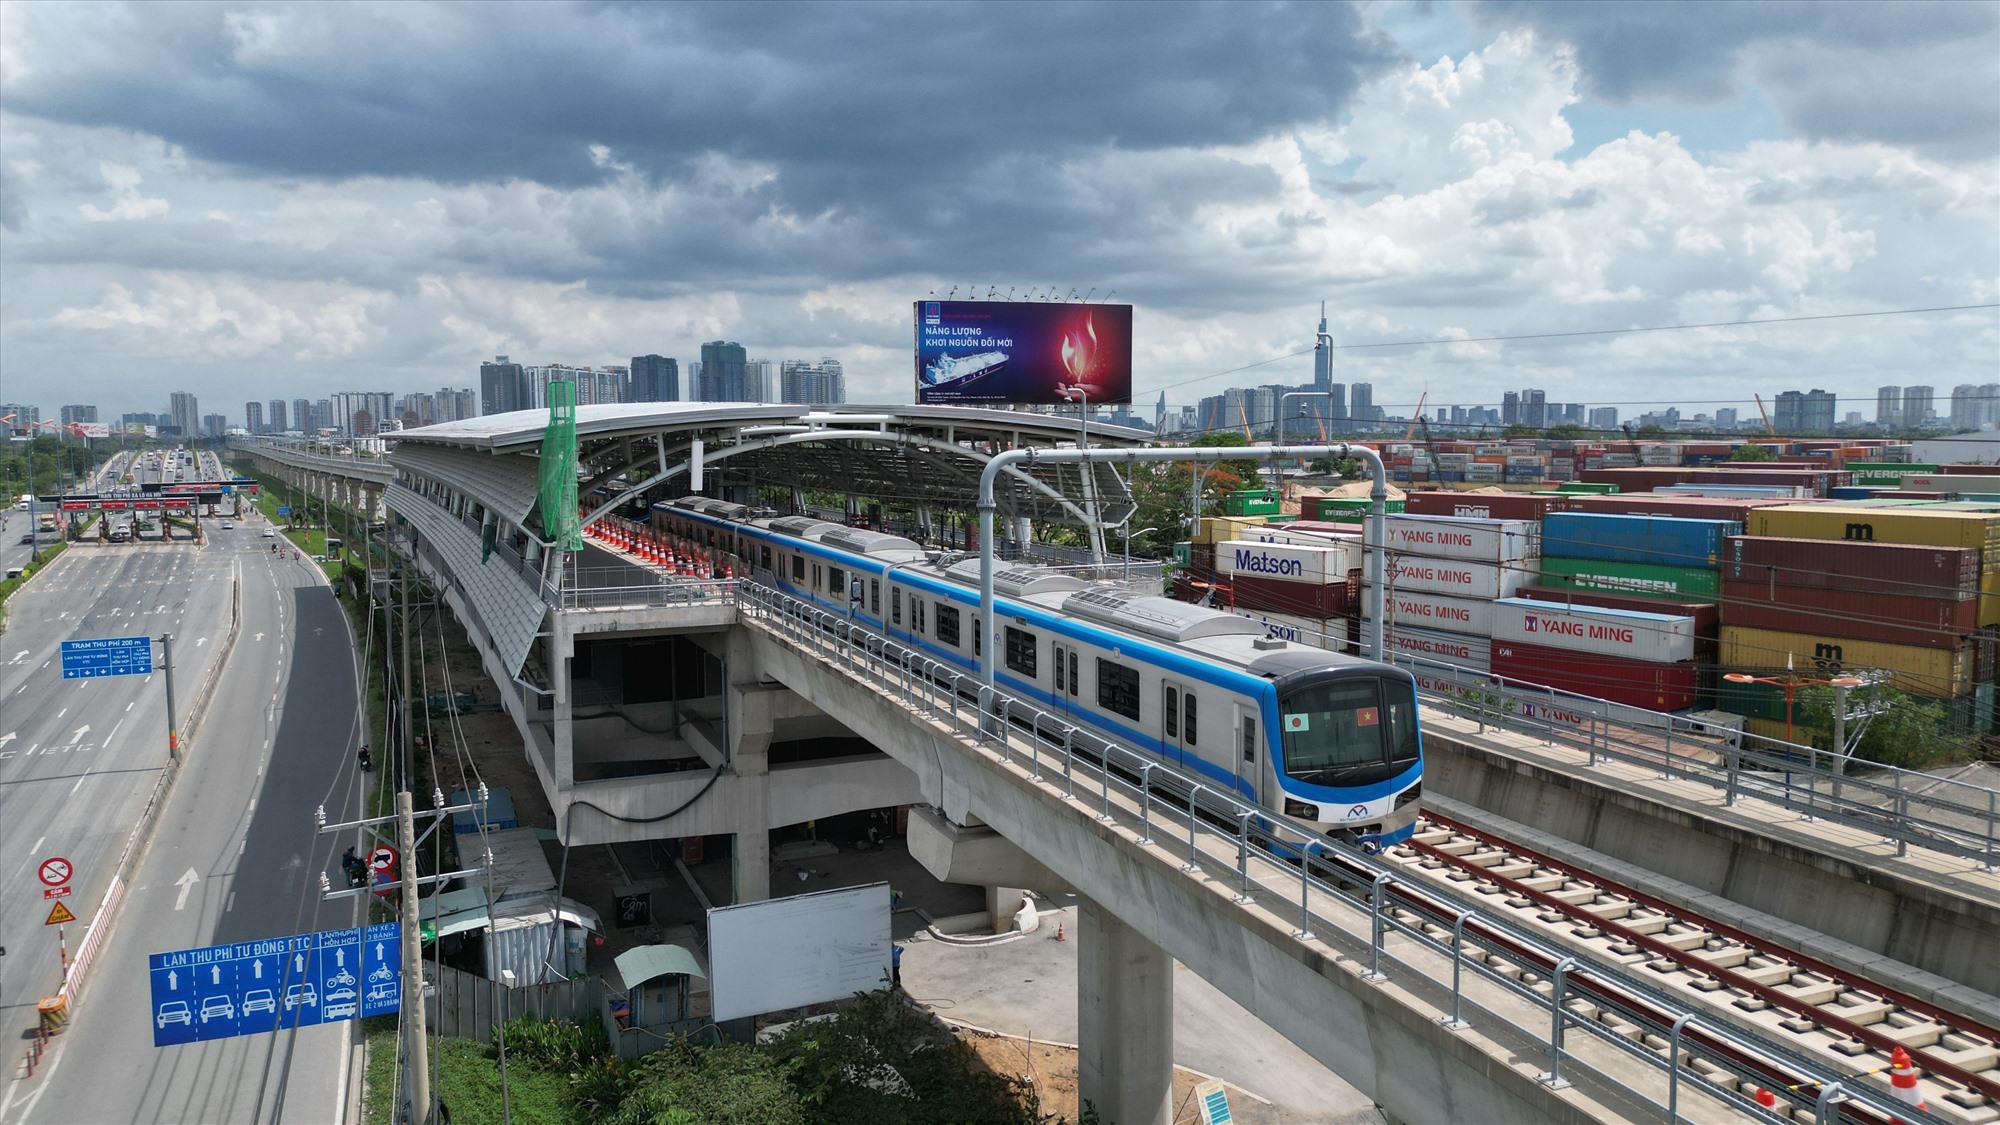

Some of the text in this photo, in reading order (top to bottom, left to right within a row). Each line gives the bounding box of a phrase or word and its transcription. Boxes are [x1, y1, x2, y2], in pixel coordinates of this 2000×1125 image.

[925, 325, 982, 337] NĂNG LƯỢNG
[997, 337, 1013, 347] MỚI
[1401, 530, 1472, 546] YANG MING
[1235, 549, 1302, 576] Matson
[1400, 566, 1472, 584] YANG MING
[1575, 573, 1677, 593] EVERGREEN
[1399, 601, 1470, 621] YANG MING
[1541, 619, 1633, 643] YANG MING
[1398, 637, 1469, 658] YANG MING
[1540, 706, 1581, 724] YANG
[367, 925, 378, 933] ÀN
[163, 951, 187, 967] LÀN
[190, 951, 212, 964] THU
[215, 945, 233, 960] PHÍ
[236, 944, 251, 957] TỰ
[253, 940, 285, 956] ĐỘNG
